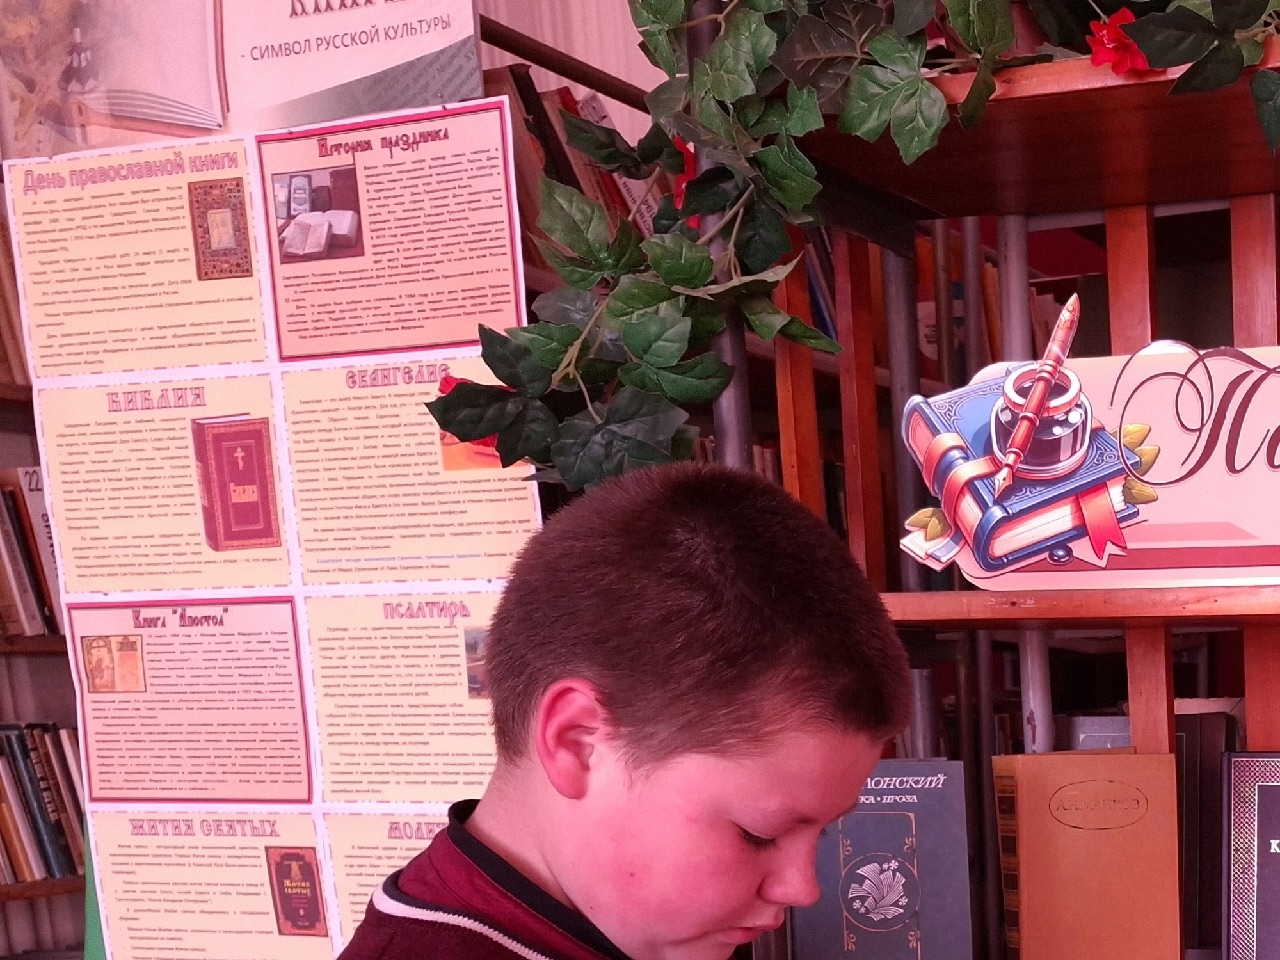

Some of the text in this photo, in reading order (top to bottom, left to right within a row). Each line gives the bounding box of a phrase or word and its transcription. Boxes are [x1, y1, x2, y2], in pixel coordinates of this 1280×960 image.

[250, 13, 451, 60] СИМВОЛ РУССКОЙ КУЛЬТУРЫ
[23, 151, 239, 195] День православной книги
[106, 387, 206, 412] БИБЛИЯ
[132, 608, 166, 629] Книга
[129, 818, 281, 838] ЖИТИЯ СВЯТЫХ
